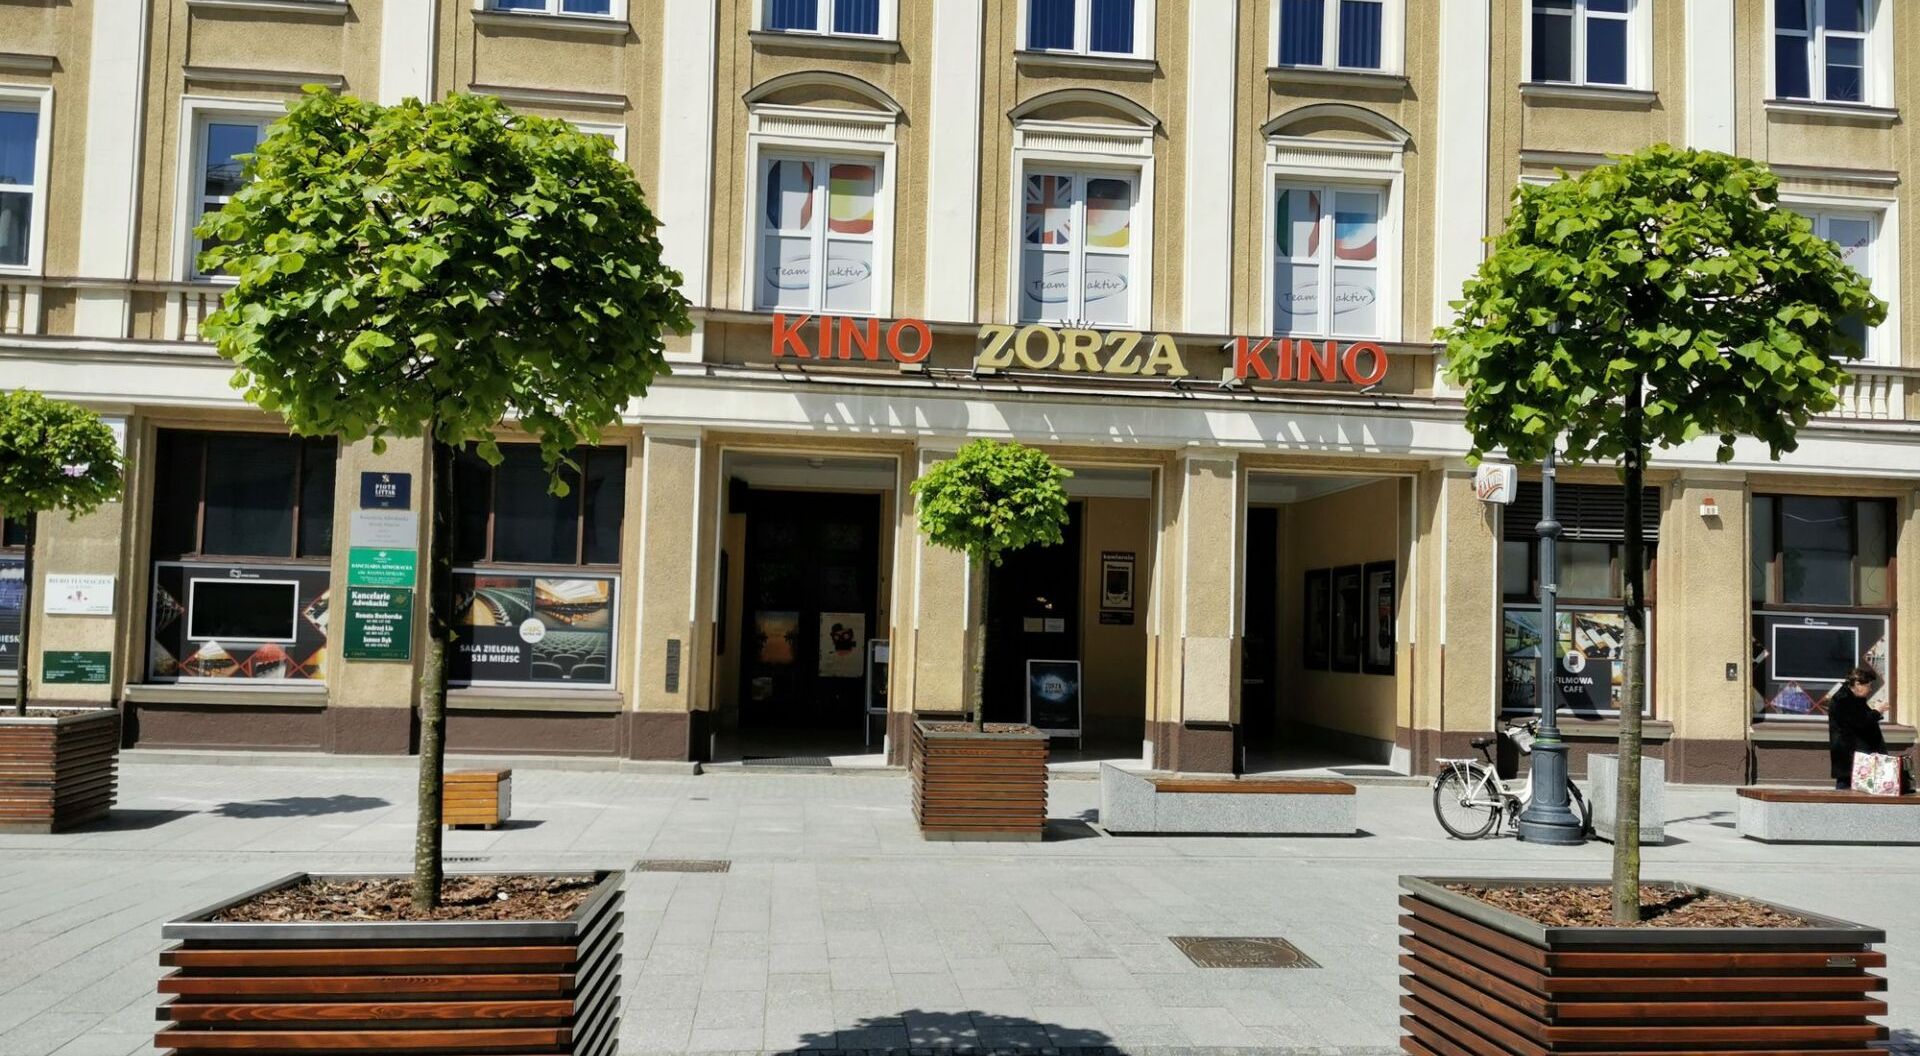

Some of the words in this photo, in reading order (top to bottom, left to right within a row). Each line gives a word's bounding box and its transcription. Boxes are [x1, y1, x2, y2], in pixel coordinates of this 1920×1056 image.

[771, 265, 809, 277] Team
[828, 266, 863, 277] aktiv
[1031, 278, 1067, 290] Team
[1086, 279, 1119, 290] aktiv
[1282, 292, 1316, 303] Team
[1335, 292, 1368, 303] aktiv
[771, 313, 933, 364] KINO
[976, 322, 1189, 378] ZORZA
[1235, 335, 1389, 386] KINO
[351, 591, 391, 601] Kancelarie
[352, 599, 389, 607] Adwokackie
[363, 624, 385, 632] Andrzej
[460, 644, 481, 653] SALA
[483, 645, 520, 654] ZIELONA
[471, 654, 487, 662] 518
[489, 655, 520, 663] MIEJSC
[1554, 676, 1593, 685] FILMOWA
[1563, 685, 1584, 693] CAFE
